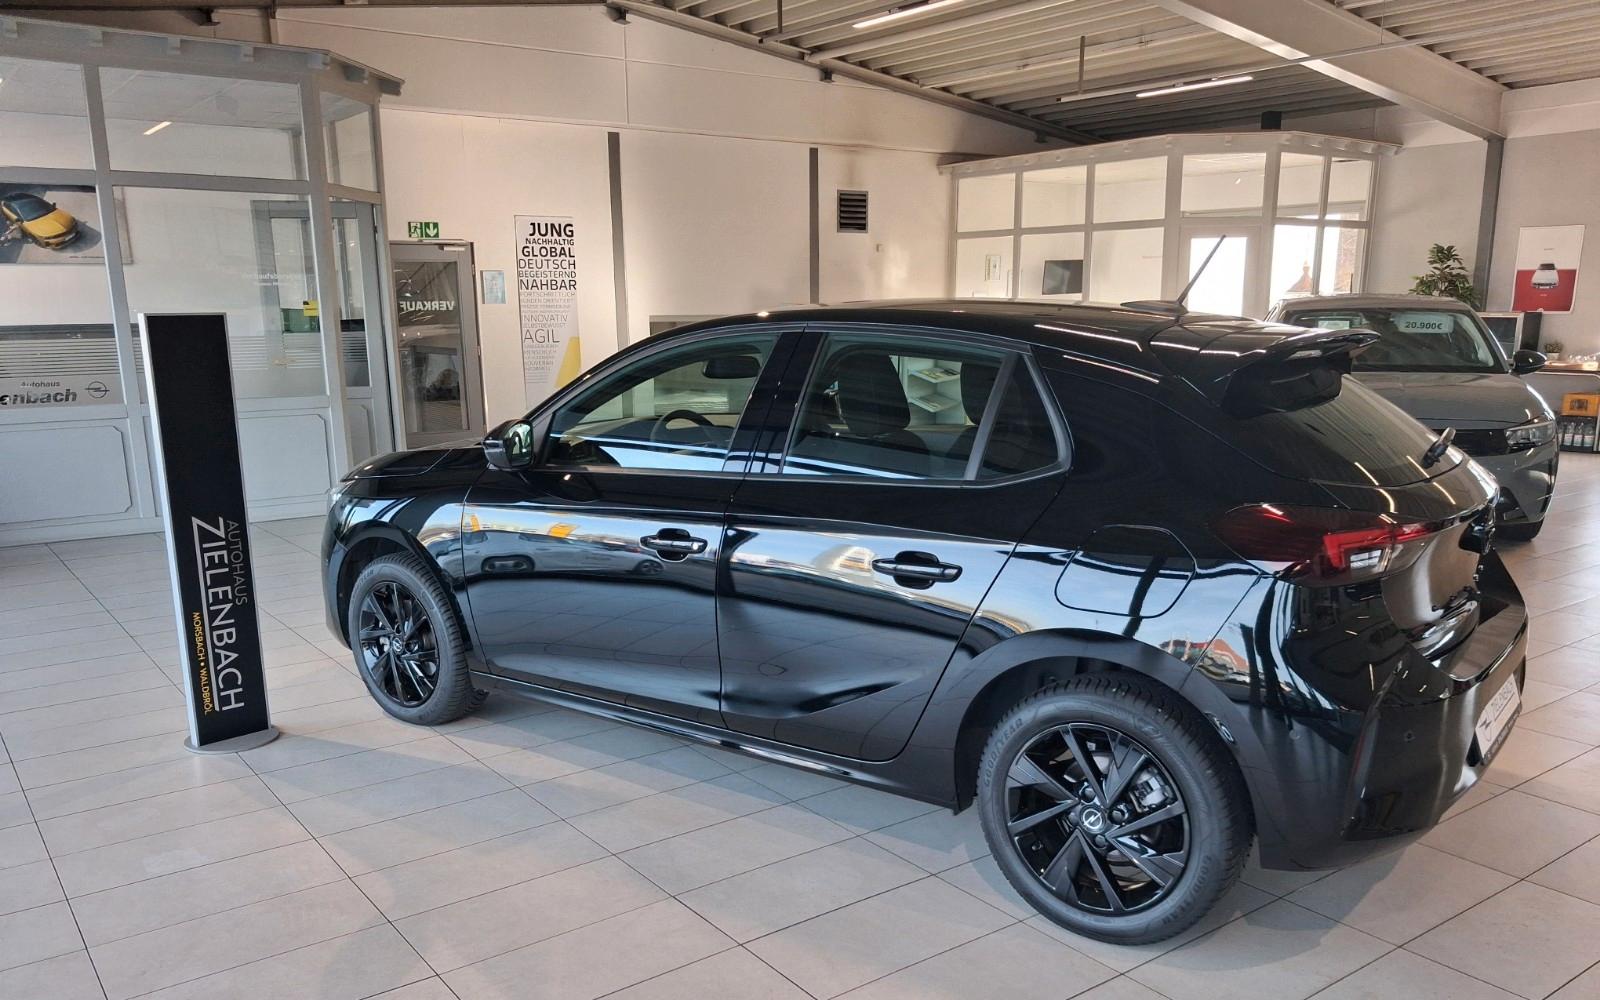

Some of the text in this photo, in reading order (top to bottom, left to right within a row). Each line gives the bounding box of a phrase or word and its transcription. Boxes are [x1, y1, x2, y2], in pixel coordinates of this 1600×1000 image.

[529, 222, 574, 238] JUNG
[525, 238, 575, 246] NACHHALTIG
[521, 245, 576, 258] GLOBAL
[518, 258, 576, 270] DEUTSCH
[518, 270, 577, 278] BEGEISTERND
[519, 278, 577, 291] NAHBAR
[1404, 321, 1444, 330] 20.900€
[524, 328, 560, 344] AGIL
[226, 520, 248, 606] AUTOHAUS
[191, 516, 245, 711] ZIELENBACH
[192, 612, 214, 715] MORSBACH WALDBRÖL
